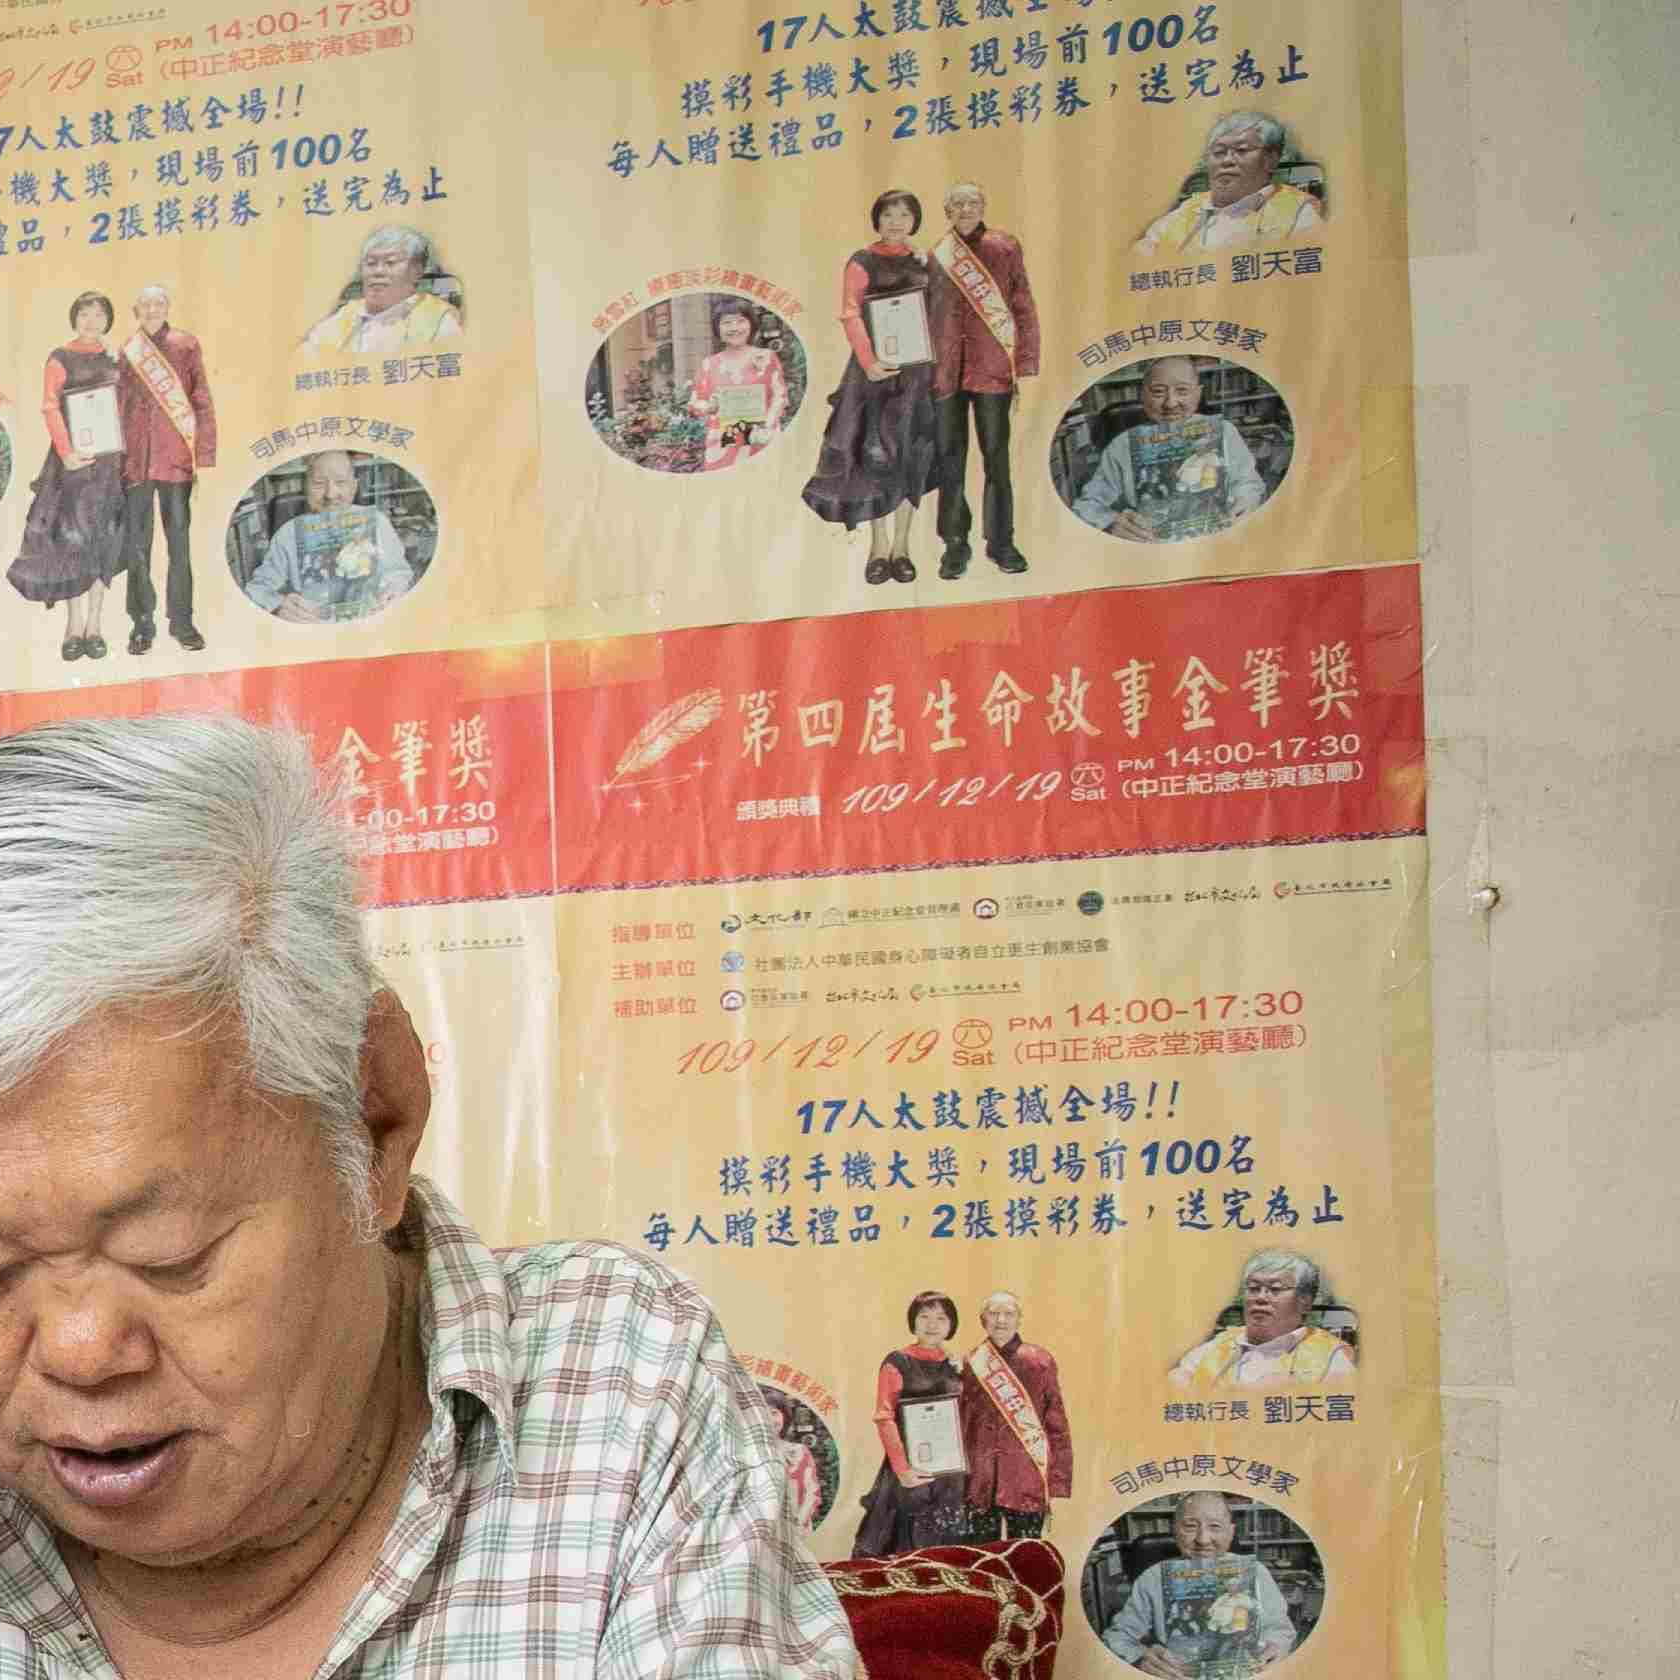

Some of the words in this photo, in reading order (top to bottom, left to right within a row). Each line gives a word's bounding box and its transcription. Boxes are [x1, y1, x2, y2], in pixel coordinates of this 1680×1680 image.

[155, 37, 193, 53] PM
[206, 0, 411, 44] 14:00-17:30
[105, 72, 143, 88] Sat
[1230, 246, 1324, 283] 劉天富
[1076, 319, 1270, 371] 司馬中原文學家
[383, 352, 462, 385] 劉天富
[250, 415, 416, 460] 司馬中原文學家
[739, 640, 1359, 768] 第四屆生命故事金筆獎
[1118, 758, 1155, 772] PM
[1165, 733, 1361, 769] 14:00-17:30
[1071, 787, 1106, 801] Sat
[1009, 1015, 1052, 1032] PM
[1066, 990, 1304, 1028] 14:00-17:30
[952, 1049, 994, 1067] Sat
[1263, 1393, 1356, 1425] 劉天富
[1109, 1455, 1300, 1498] 司馬中原文學家
